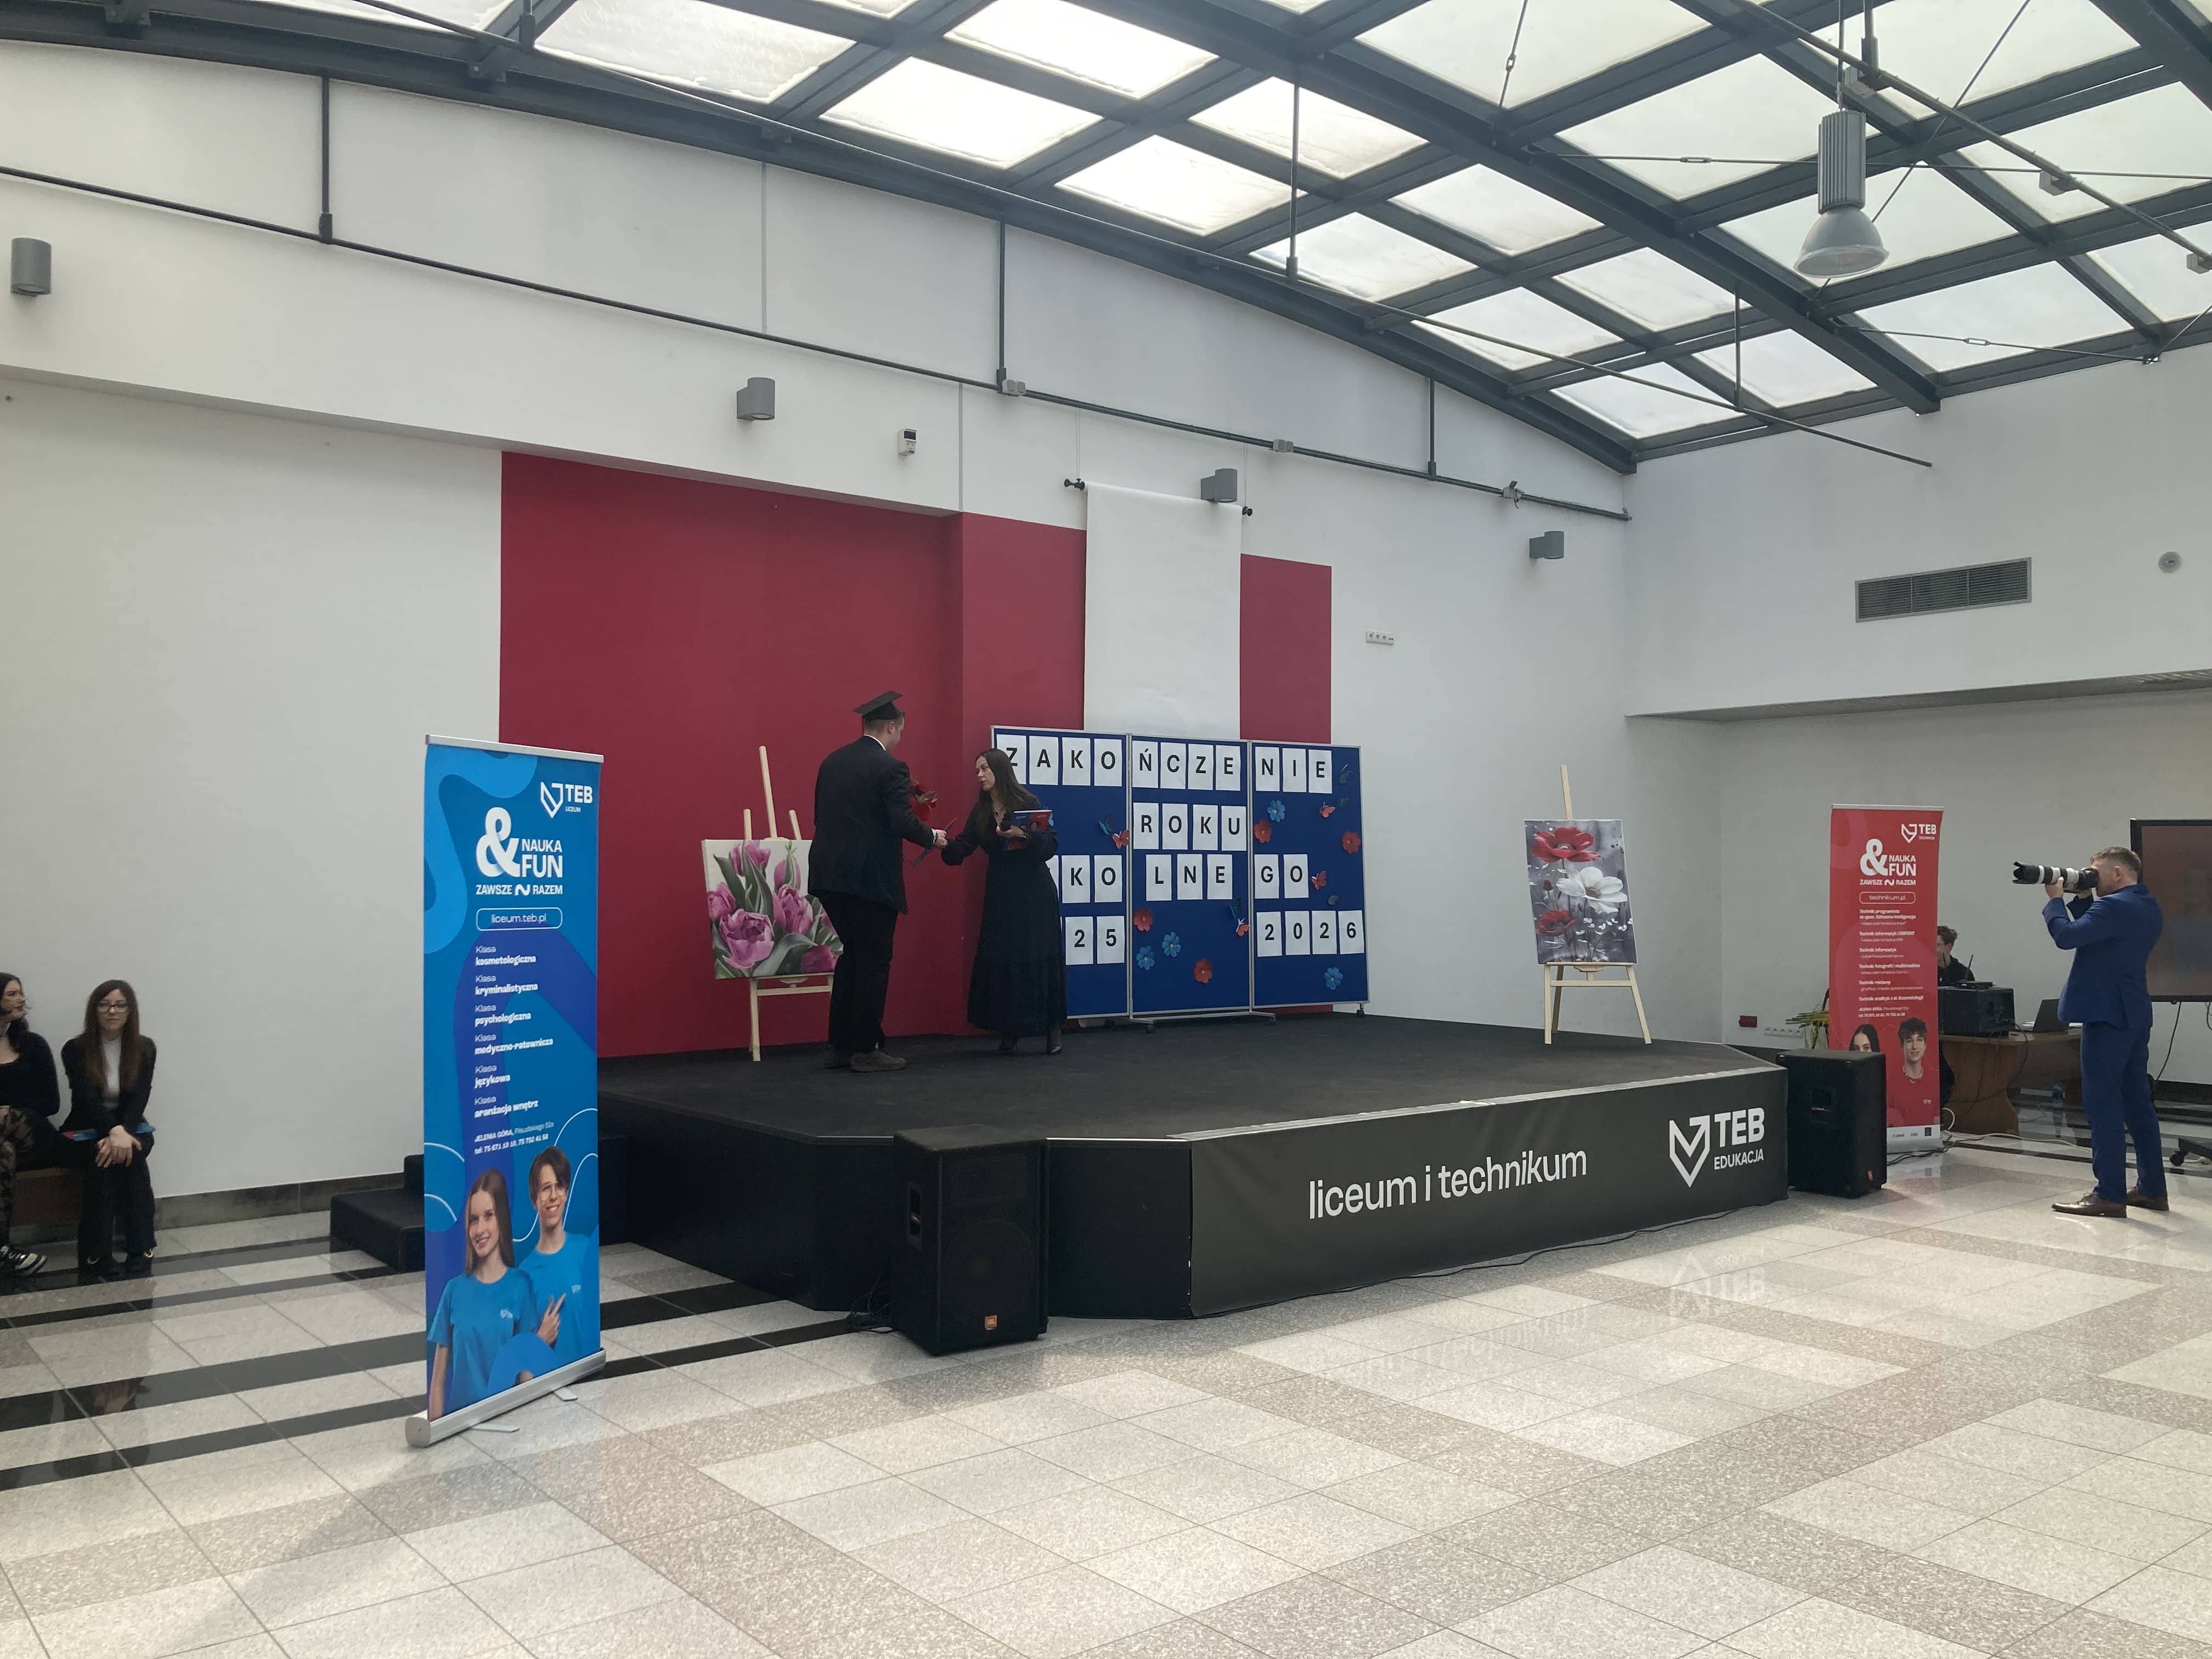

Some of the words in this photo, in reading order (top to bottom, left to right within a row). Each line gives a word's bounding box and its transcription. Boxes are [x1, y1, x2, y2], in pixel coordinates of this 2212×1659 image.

[565, 783, 593, 804] TEB
[1141, 815, 1240, 836] ROKU
[1918, 823, 1936, 834] TEB
[476, 807, 520, 877] &
[522, 839, 562, 853] NAUKA
[1860, 838, 1888, 876] &
[522, 855, 563, 878] FUN
[1889, 864, 1916, 876] FUN
[476, 884, 512, 895] ZAWSZE
[533, 884, 563, 895] RAZEM
[491, 913, 547, 924] liceum.teb.pl
[1074, 929, 1117, 947] 25
[1265, 922, 1357, 940] 2026
[475, 955, 536, 966] kosmetologiczna
[475, 974, 496, 983] Klasa
[475, 983, 538, 997] kryminalistyczna
[475, 1005, 496, 1013] Klasa
[475, 1012, 531, 1028] psychologiczna
[475, 1034, 496, 1042] Klasa
[475, 1038, 553, 1055] medyczno-ratownicza
[475, 1065, 496, 1074] Klasa
[474, 1074, 510, 1088] językowa
[475, 1096, 496, 1105] Klasa
[475, 1105, 512, 1118] aranżacja
[513, 1099, 538, 1111] wnętrz
[1714, 1107, 1765, 1148] TEB
[1713, 1148, 1764, 1170] EDUKACJA
[1309, 1175, 1417, 1219] liceum
[1424, 1165, 1431, 1202] i
[1438, 1149, 1587, 1199] technikum
